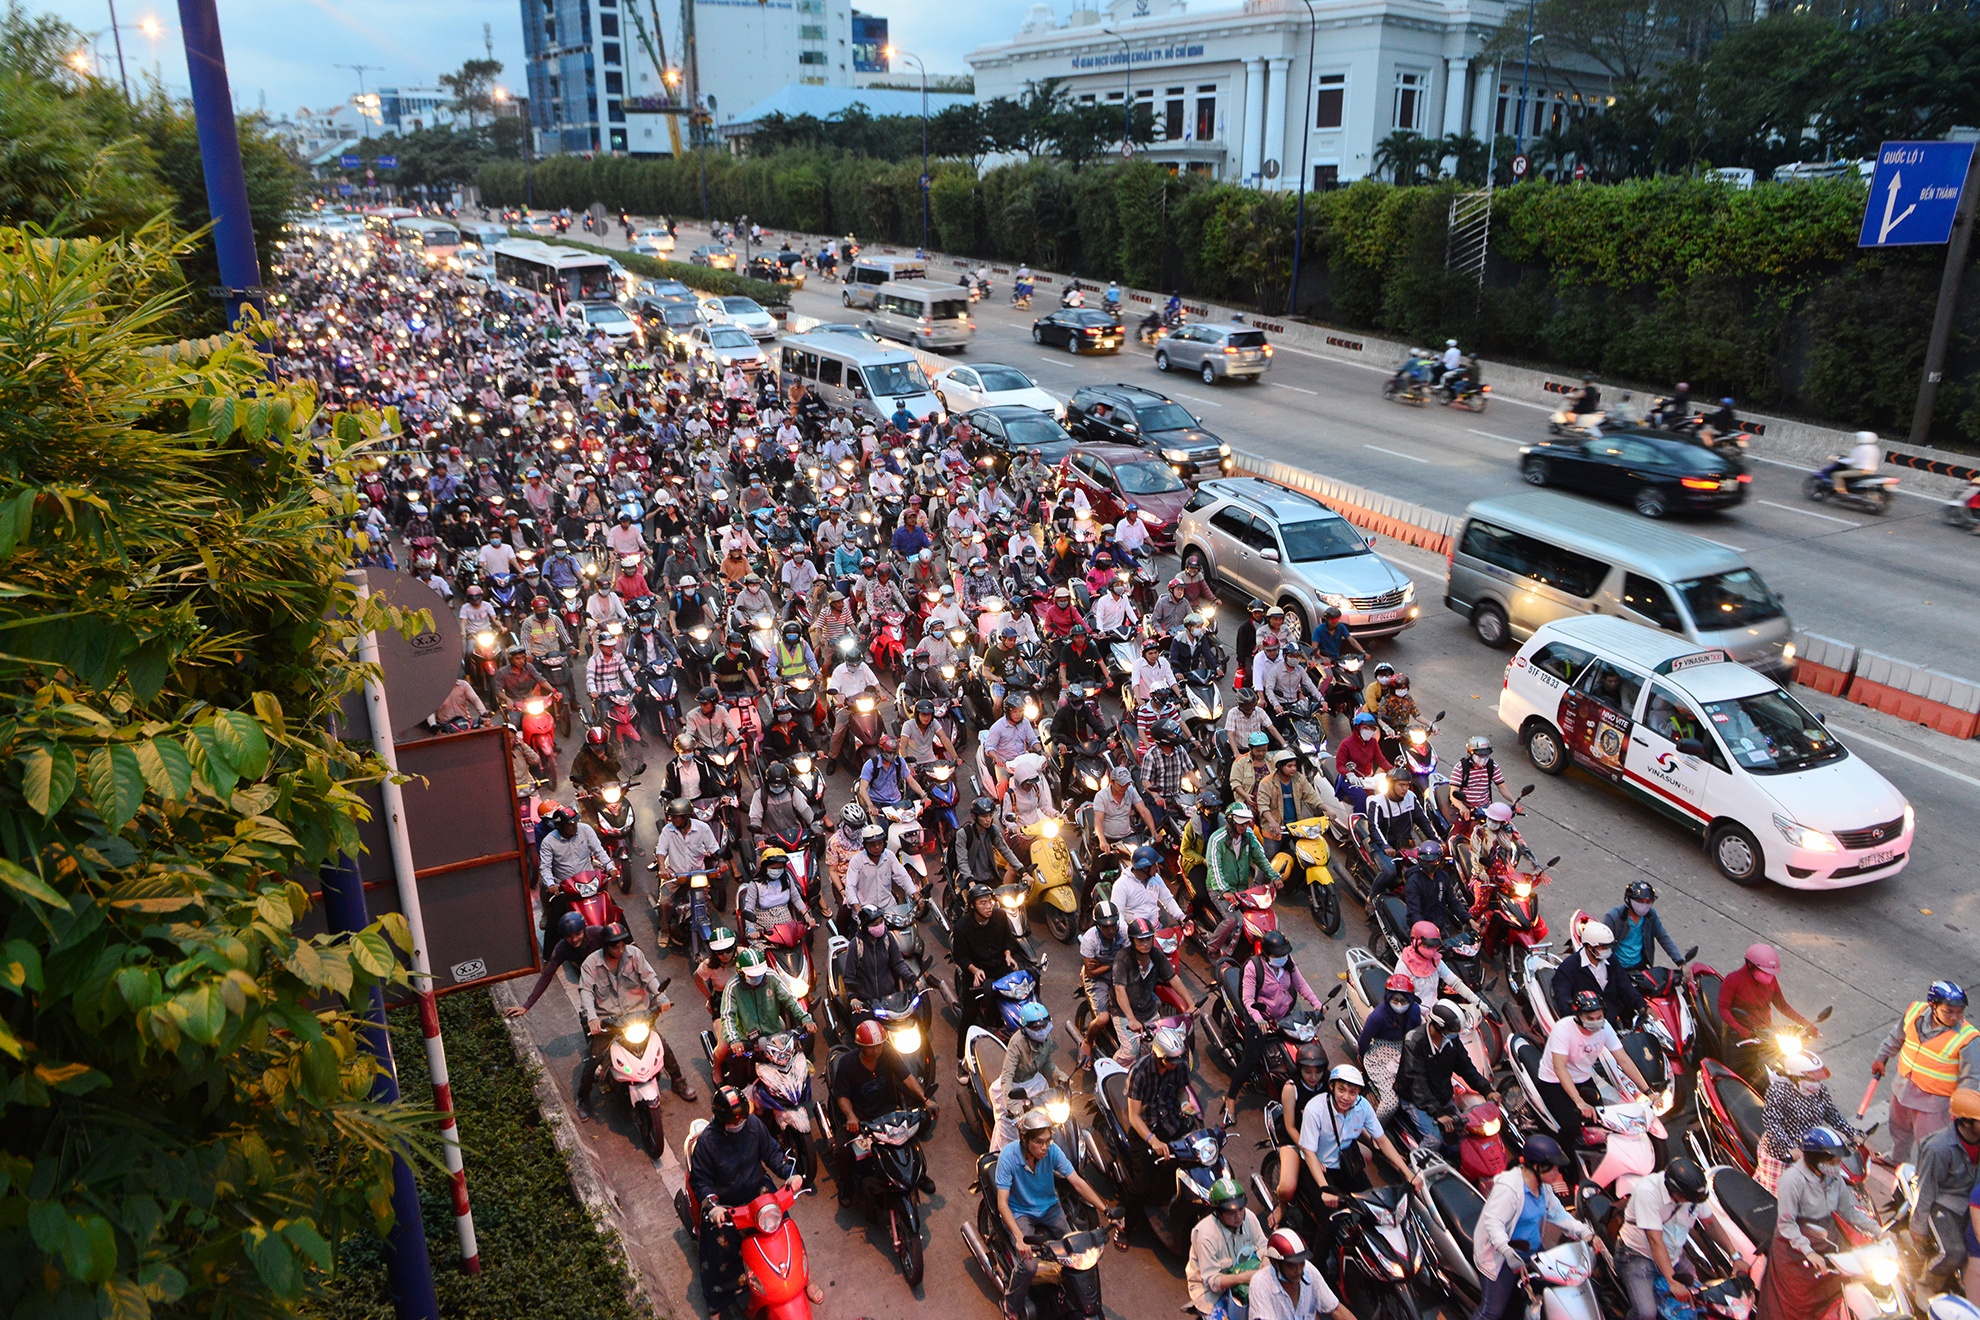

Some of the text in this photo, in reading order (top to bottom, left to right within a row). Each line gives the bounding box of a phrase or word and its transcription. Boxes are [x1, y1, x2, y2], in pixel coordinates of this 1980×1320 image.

[1883, 147, 1925, 166] QUỐC LỘ 1
[1919, 183, 1959, 201] BẾN THÀNH
[1527, 665, 1539, 678] 51F
[1615, 716, 1629, 729] VITE
